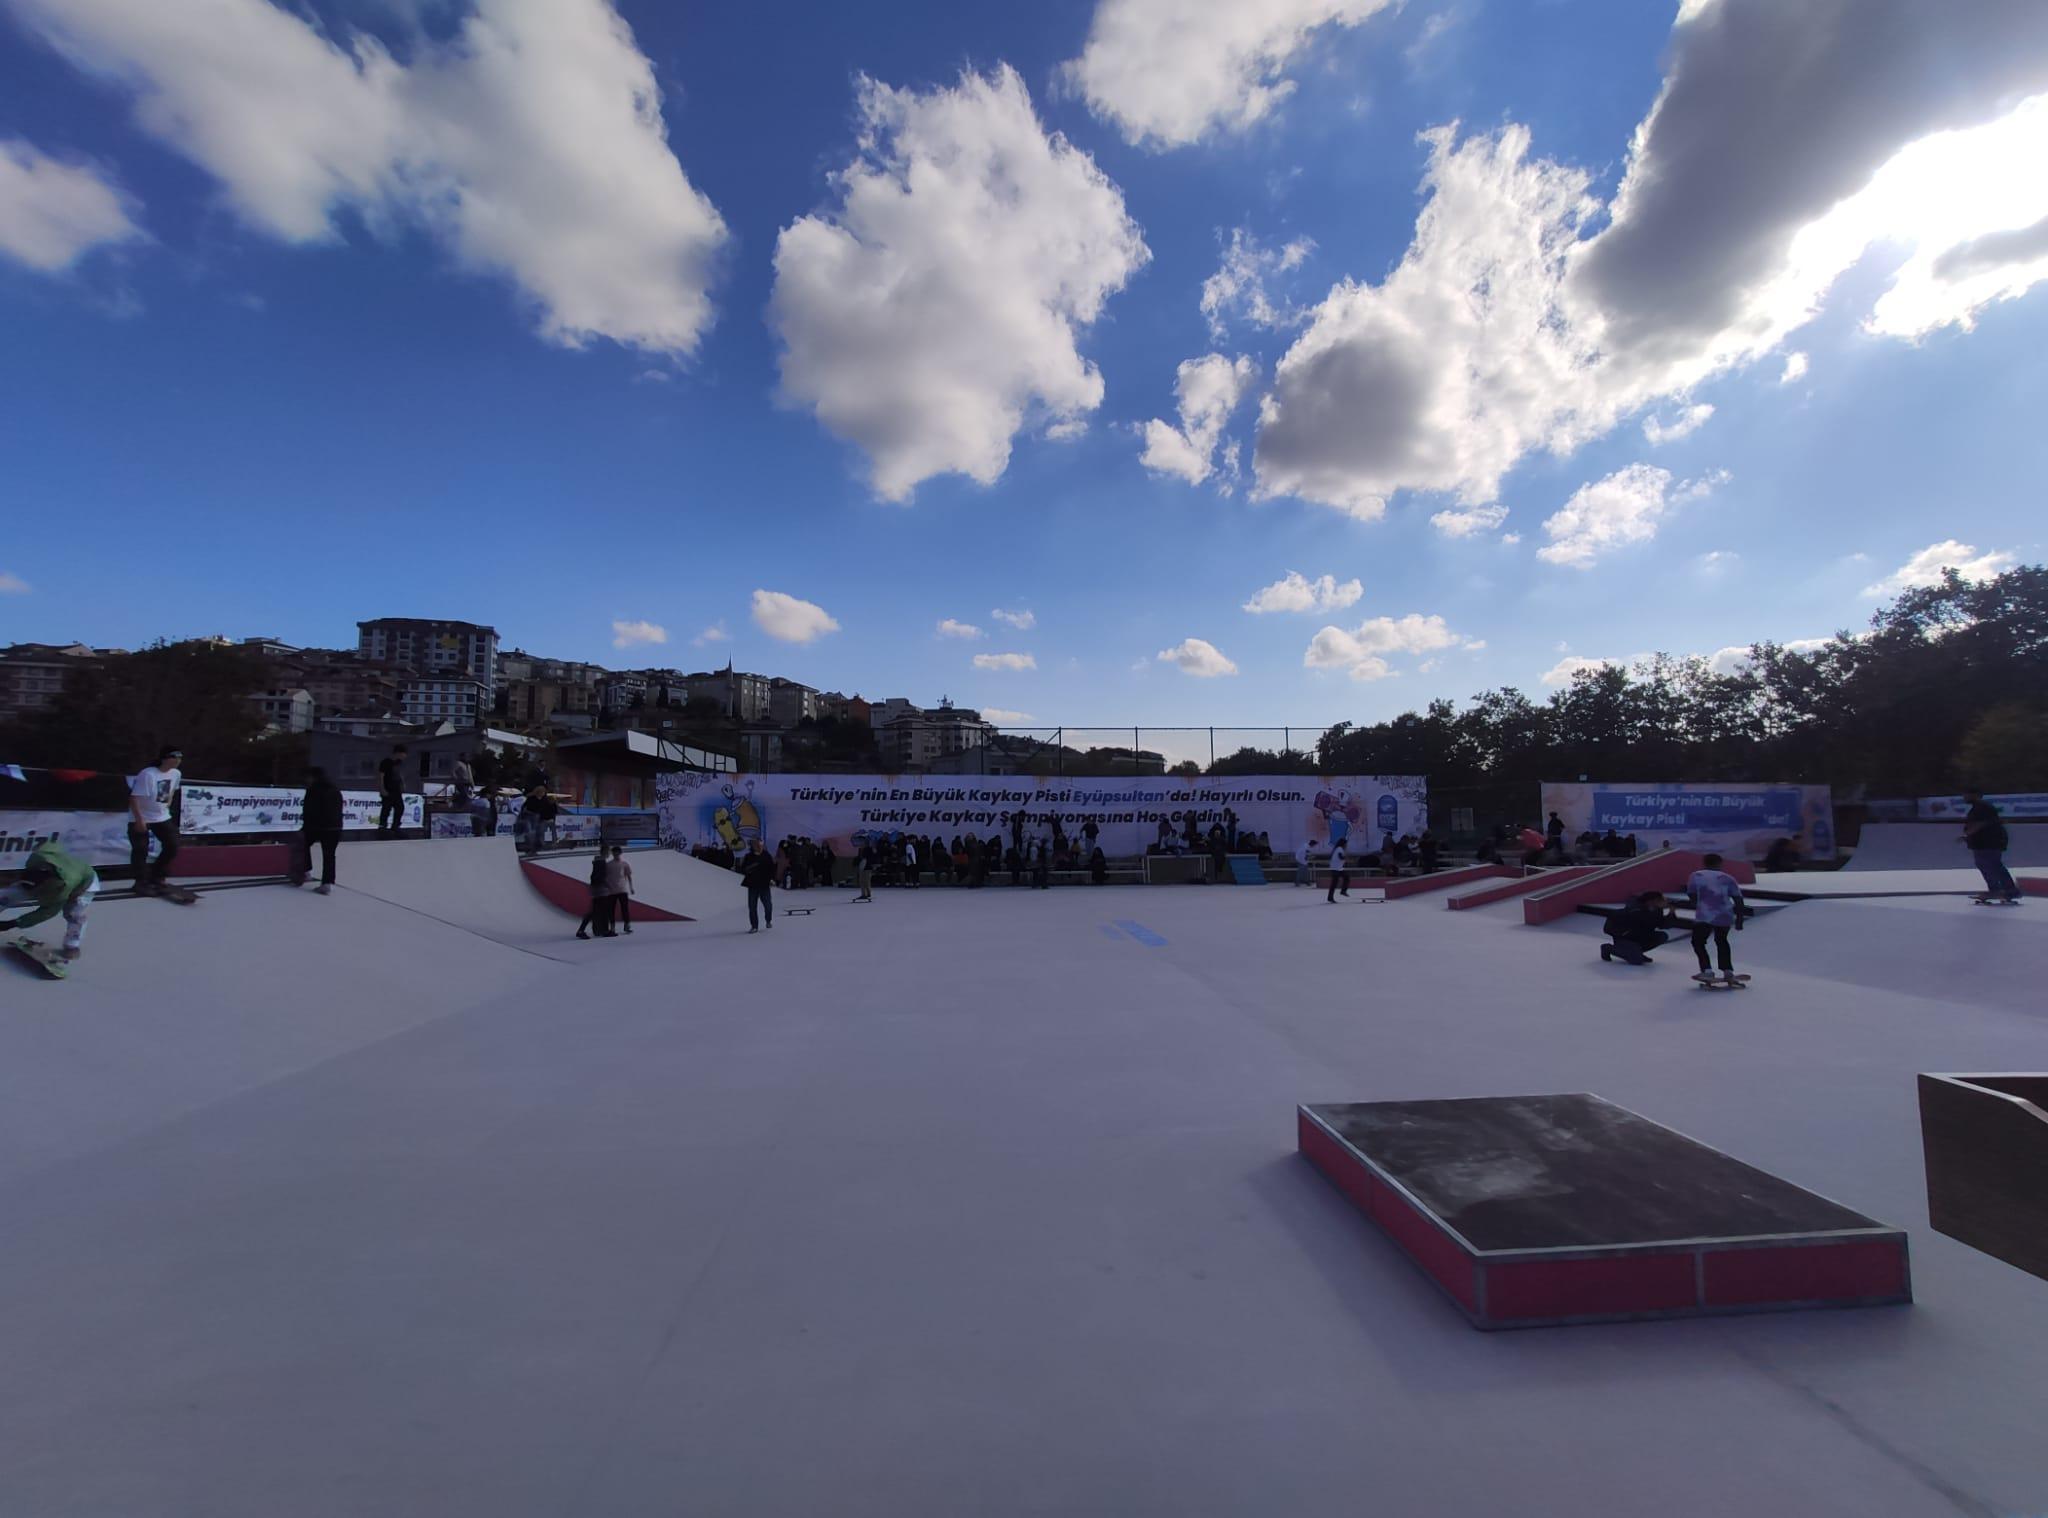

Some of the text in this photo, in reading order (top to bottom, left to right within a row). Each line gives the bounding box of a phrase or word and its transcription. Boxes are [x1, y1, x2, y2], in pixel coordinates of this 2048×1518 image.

[217, 796, 292, 810] Şampiyonaya
[790, 787, 1305, 805] Türkiye'nin En Büyük Kaykay Pisti Eyüpsultan'da! Hayırlı Olsun.
[1703, 796, 1719, 806] En
[1721, 796, 1766, 809] Büyük
[860, 808, 926, 825] Türkiye
[928, 810, 997, 826] Kaykay
[1600, 814, 1655, 828] Kaykay
